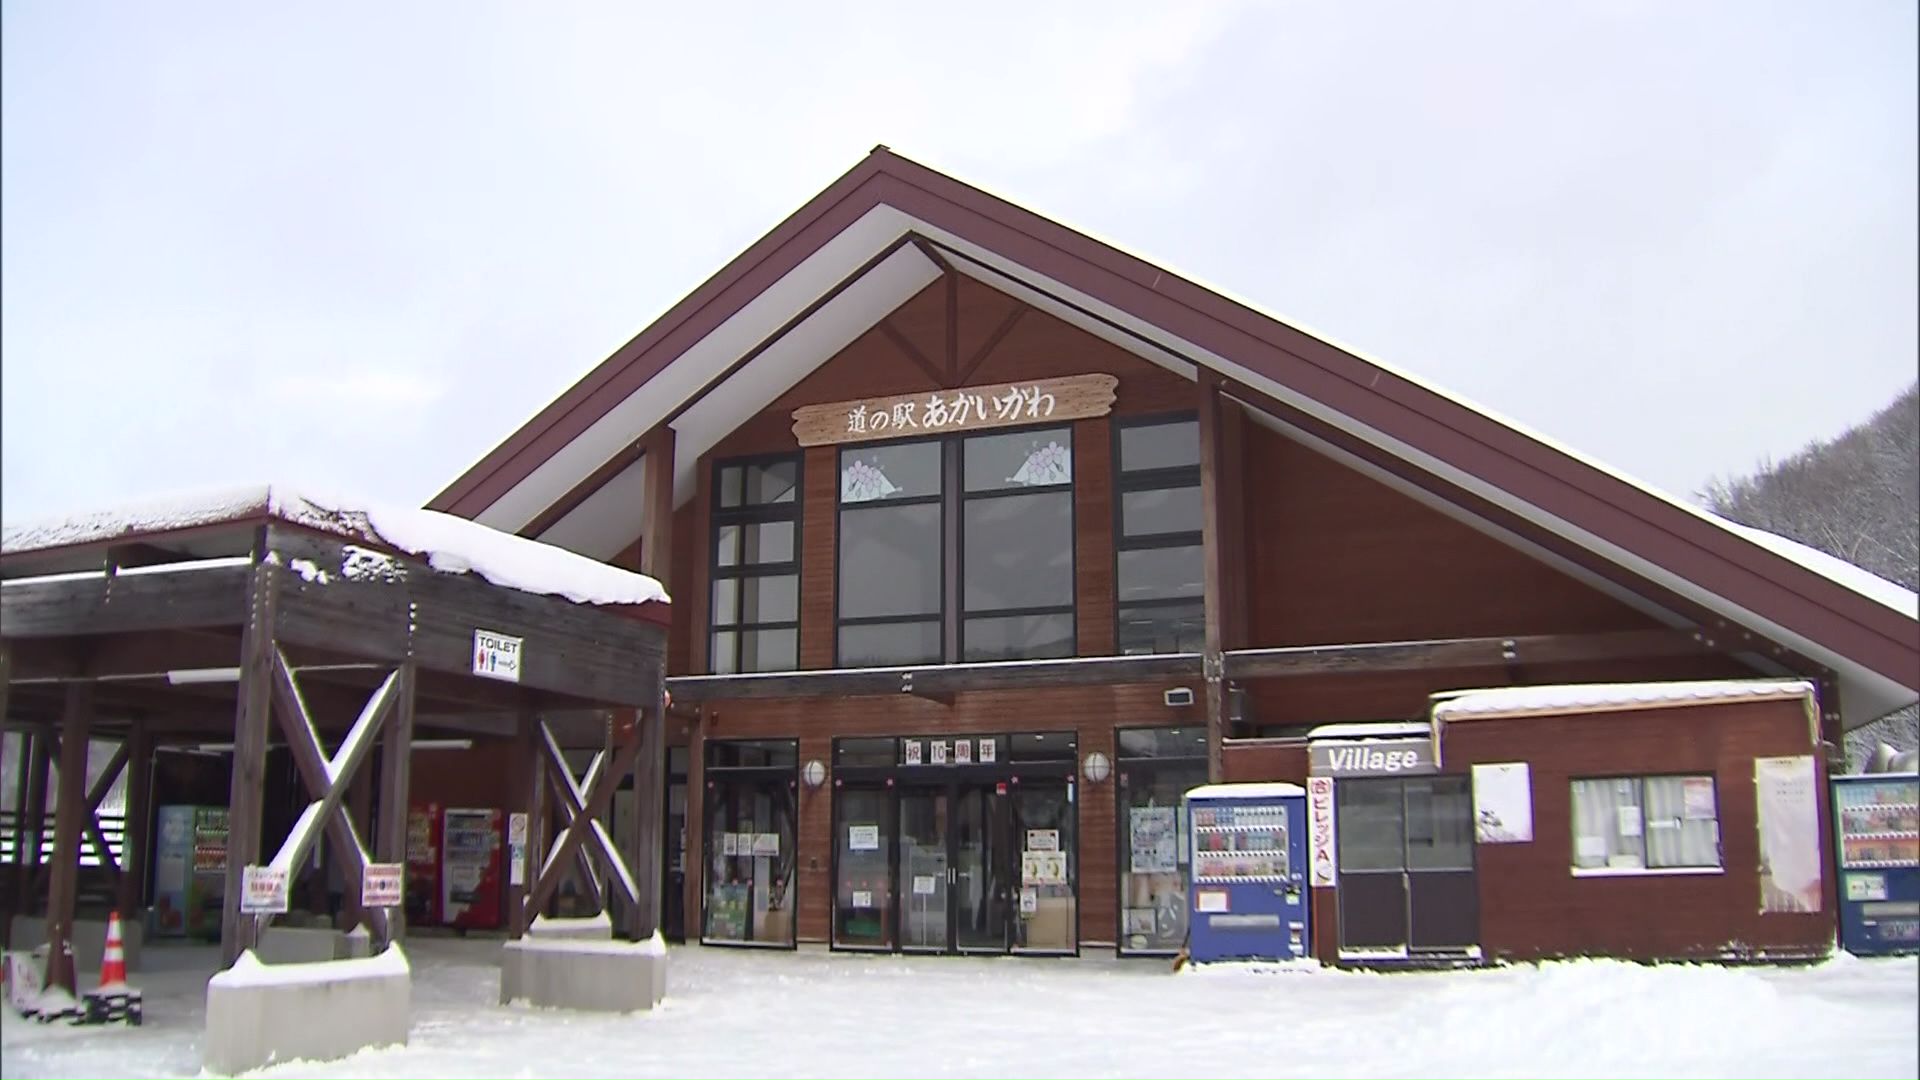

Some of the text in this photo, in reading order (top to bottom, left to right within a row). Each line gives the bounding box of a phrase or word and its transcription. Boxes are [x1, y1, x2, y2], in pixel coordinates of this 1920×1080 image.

[848, 386, 1055, 433] 道の駅 あかいがわ
[478, 637, 517, 653] TOILET
[1328, 748, 1418, 772] Village
